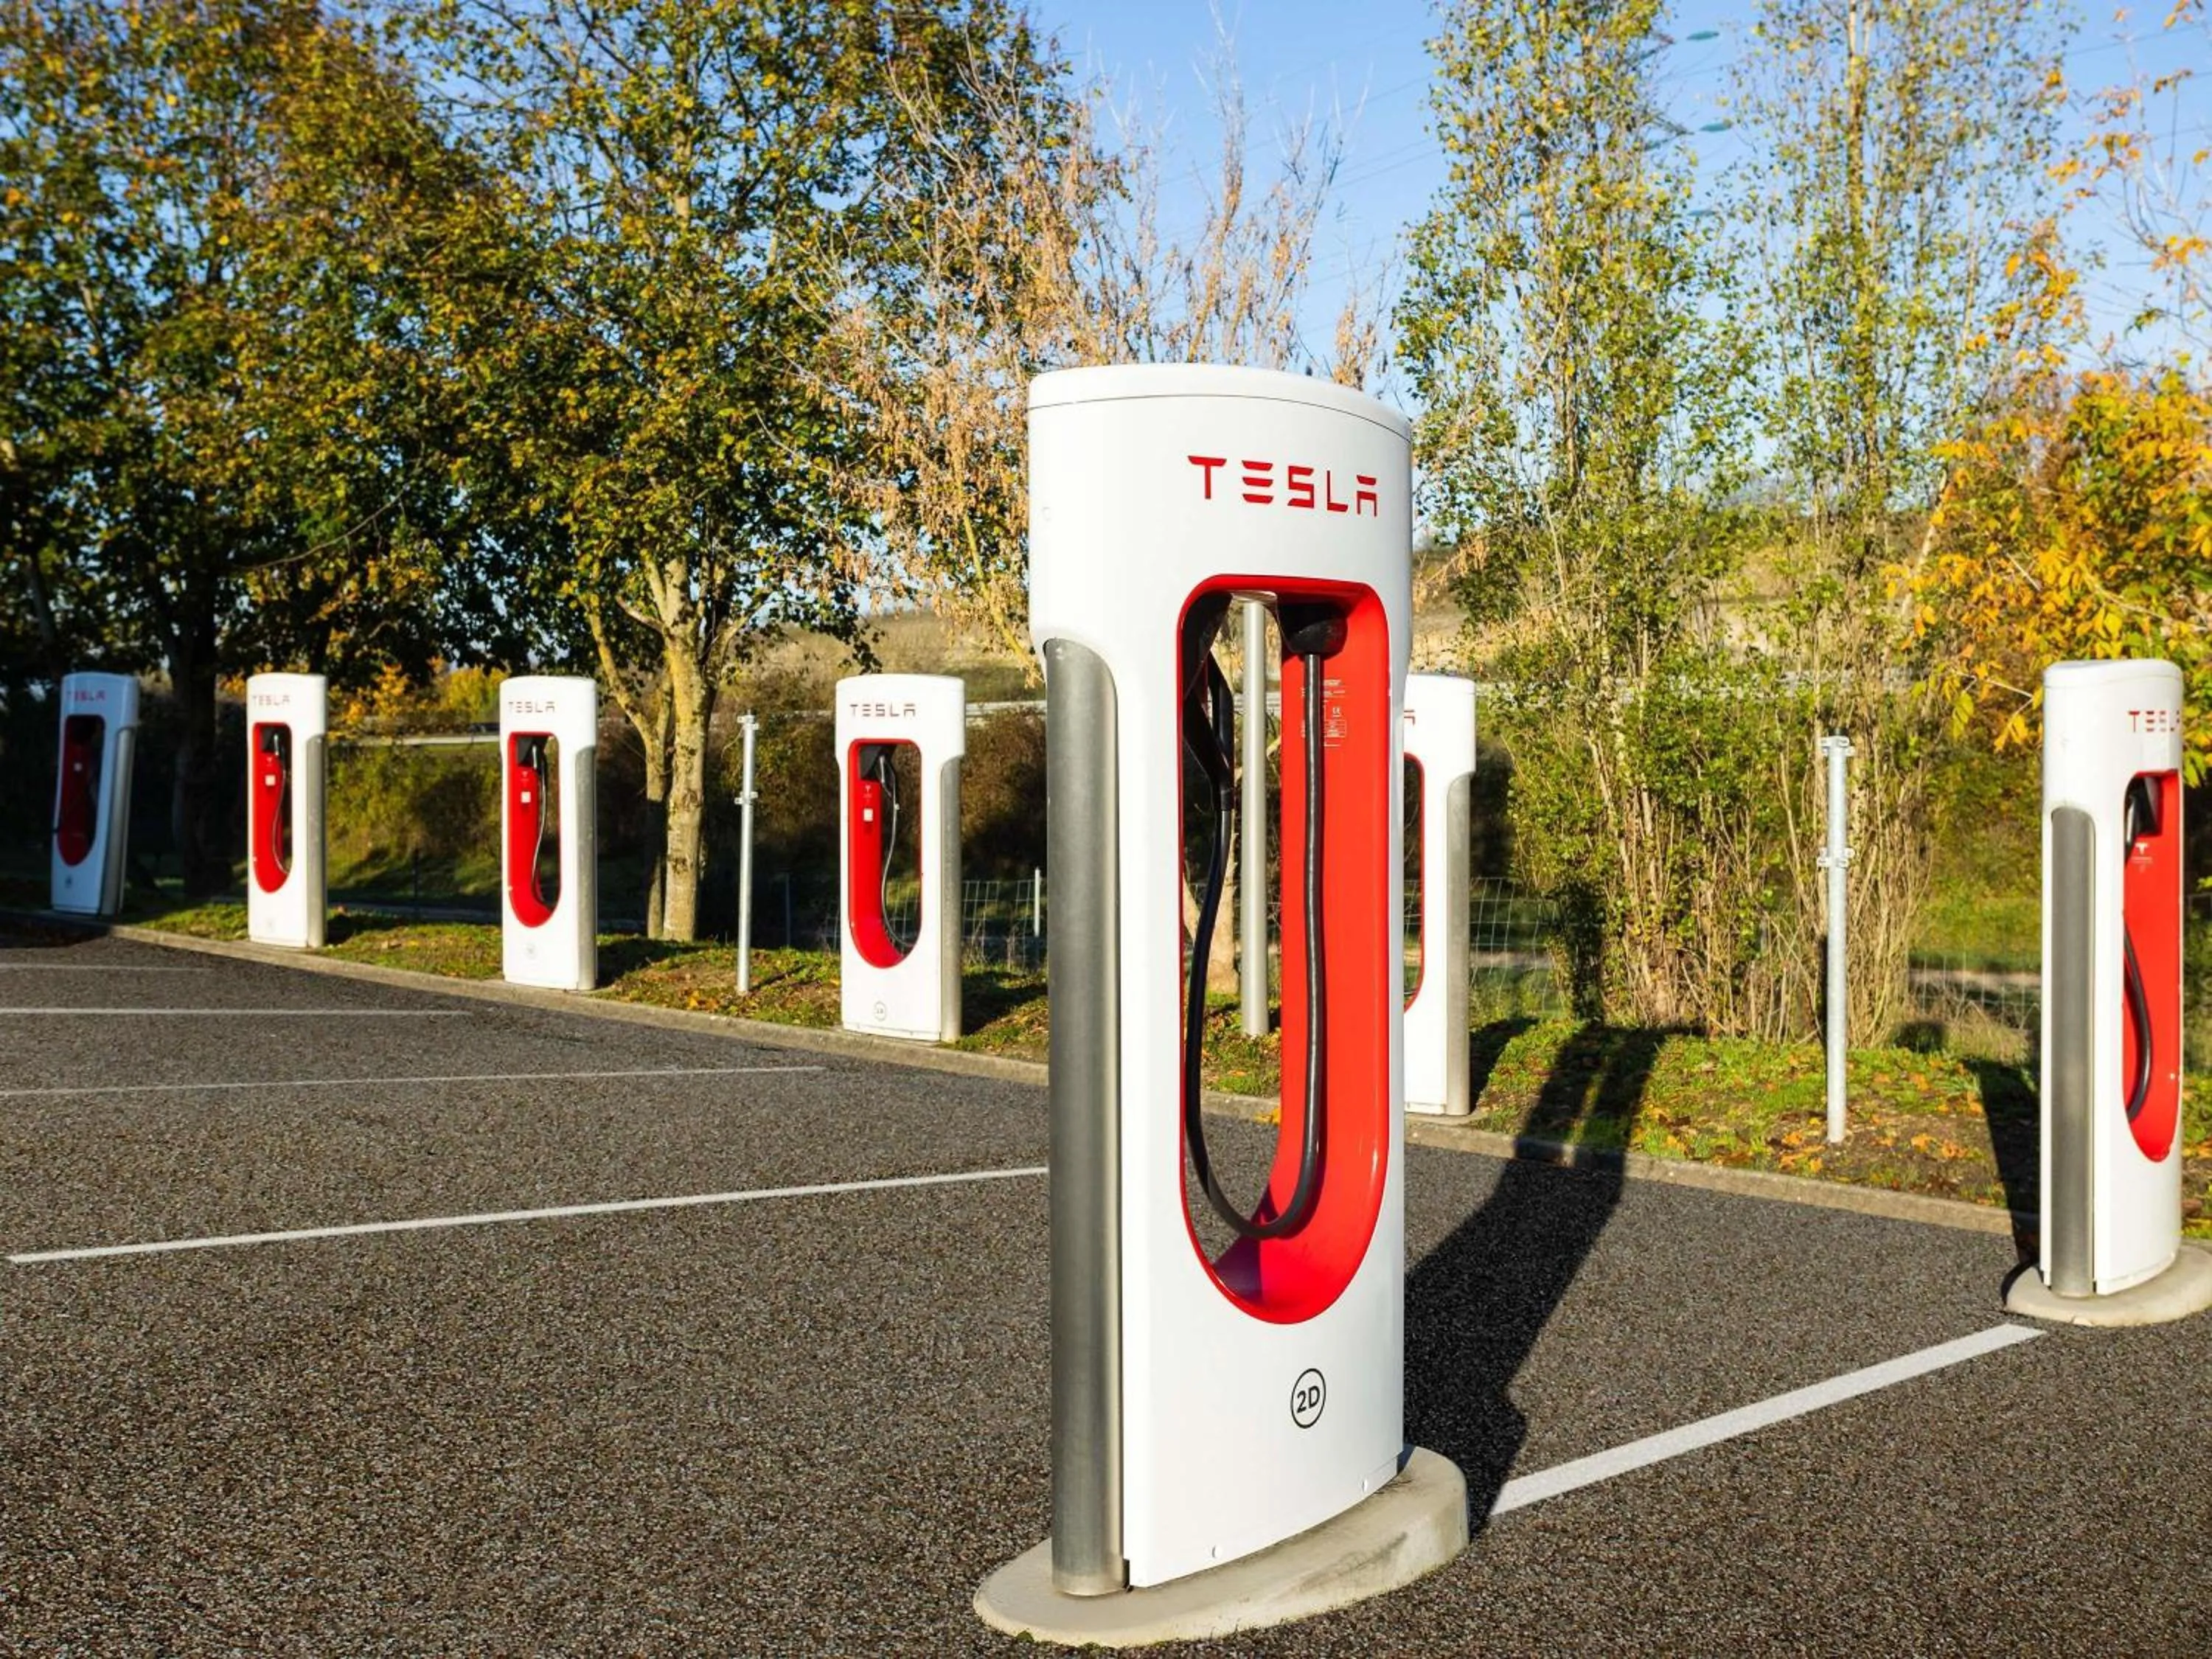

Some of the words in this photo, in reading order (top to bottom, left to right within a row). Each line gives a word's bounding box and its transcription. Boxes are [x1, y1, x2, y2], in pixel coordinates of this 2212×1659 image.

[1187, 455, 1377, 517] TESLA
[509, 701, 555, 713] TESLA
[849, 703, 916, 717] TESLA
[1296, 1385, 1321, 1413] 2D
